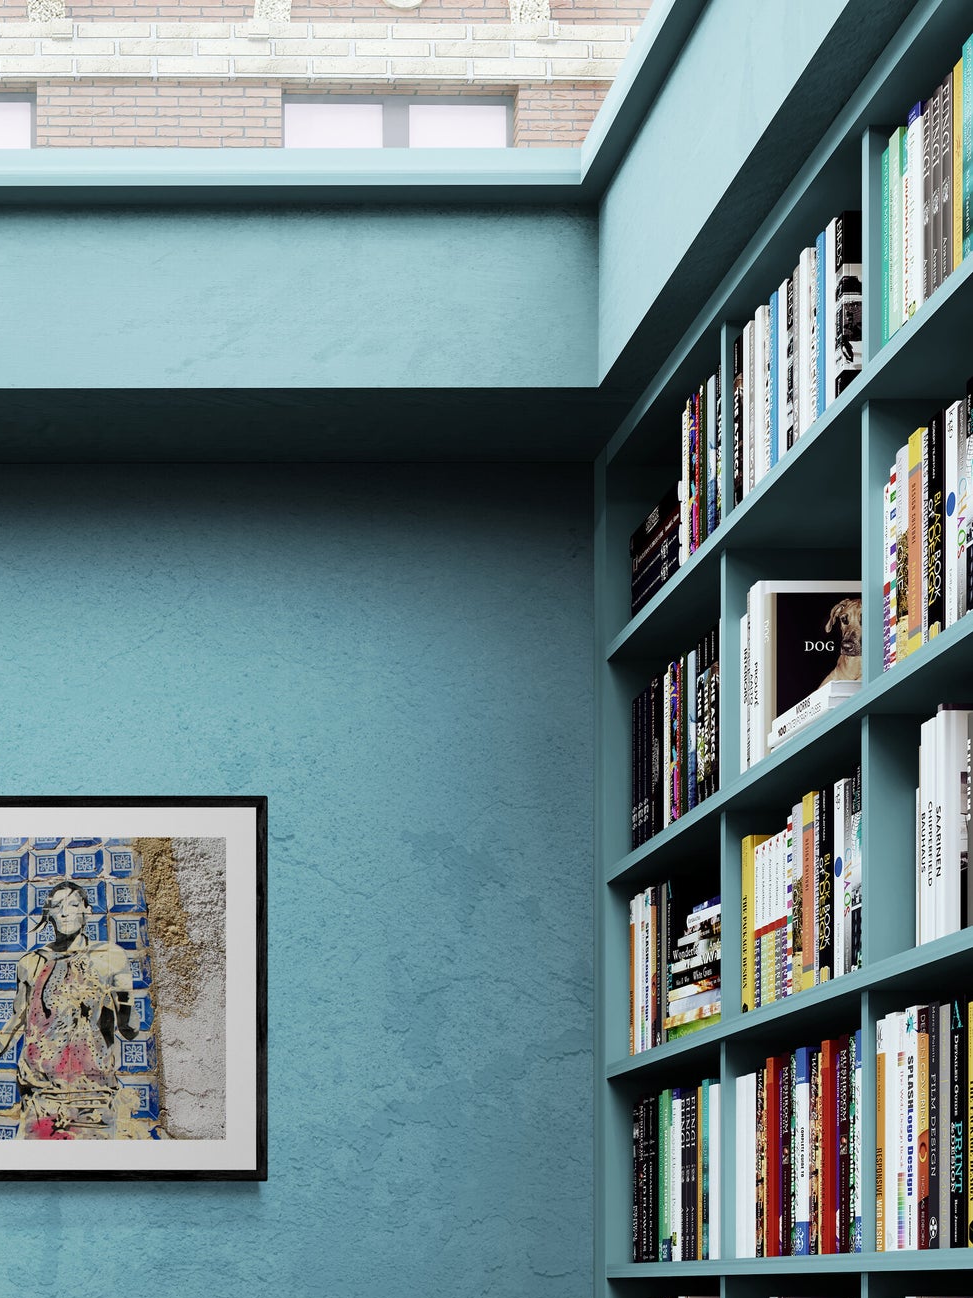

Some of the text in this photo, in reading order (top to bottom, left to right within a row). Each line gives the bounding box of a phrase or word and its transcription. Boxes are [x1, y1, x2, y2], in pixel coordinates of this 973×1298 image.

[942, 83, 950, 156] FUNGI
[957, 478, 967, 559] CHAOS
[804, 641, 834, 651] DOG
[796, 698, 810, 714] MORRIS
[778, 725, 786, 737] 100
